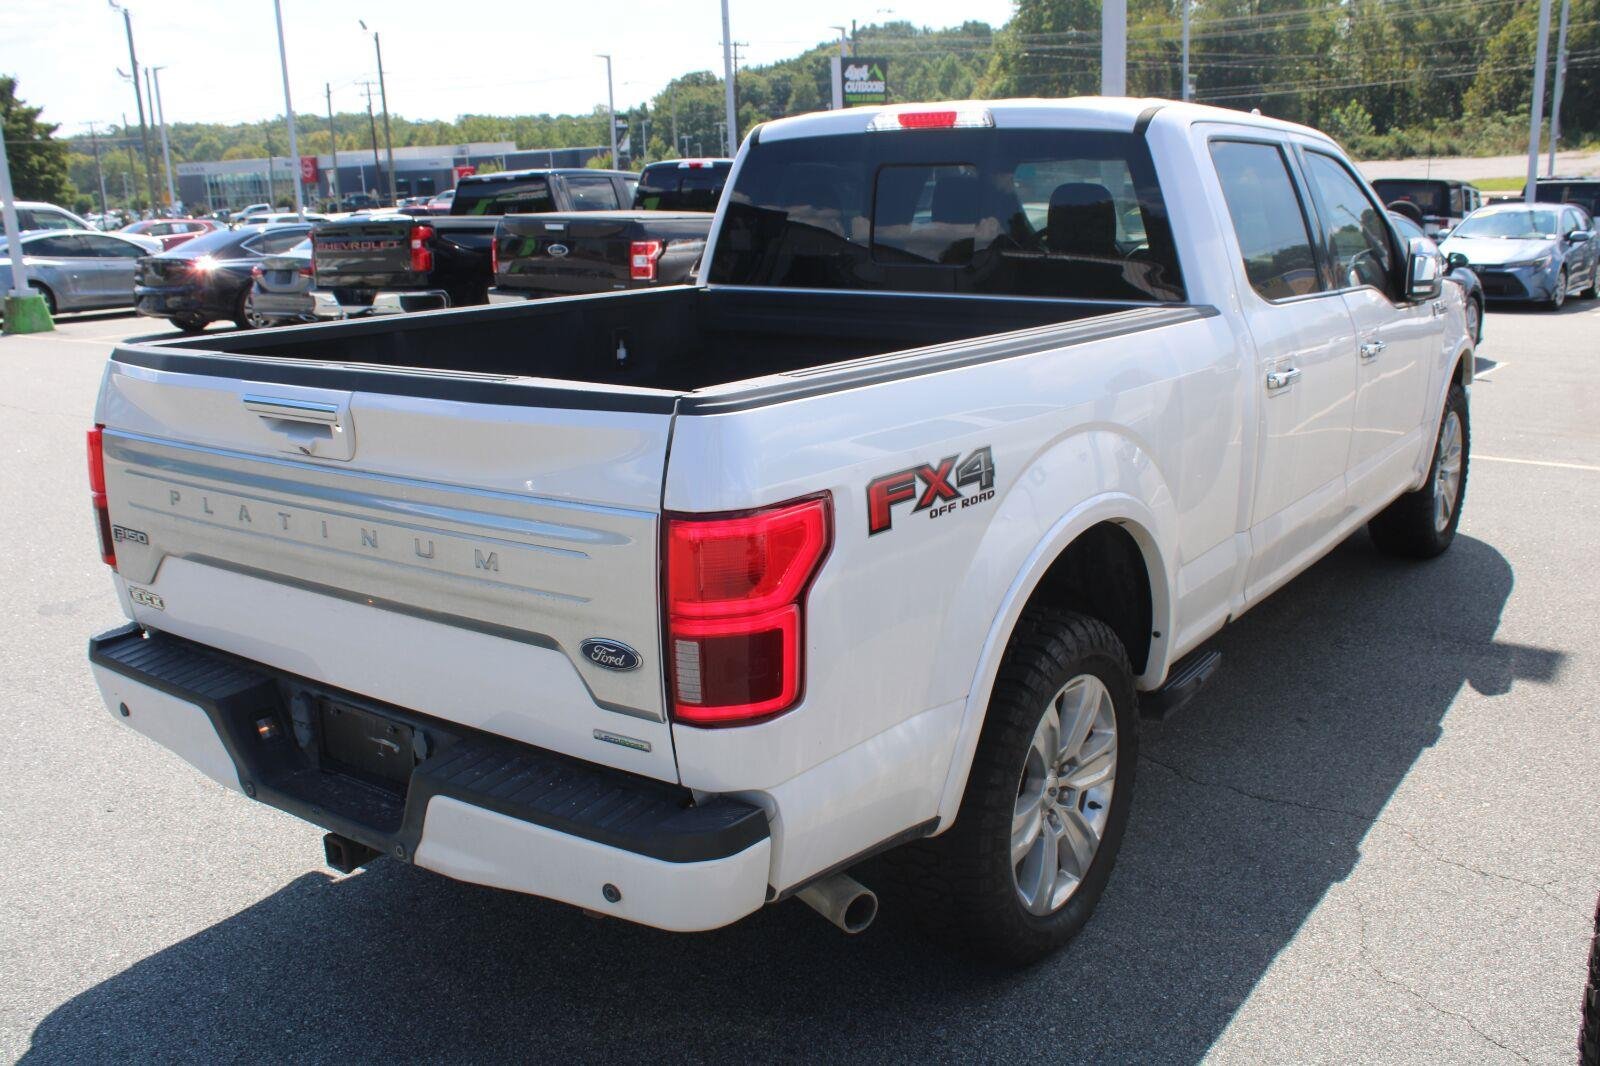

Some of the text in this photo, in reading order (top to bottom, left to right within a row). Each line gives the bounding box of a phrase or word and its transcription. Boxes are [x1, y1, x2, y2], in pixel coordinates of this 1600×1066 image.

[844, 81, 886, 93] OUTDOORS
[315, 241, 400, 251] CHEVROLET
[866, 445, 995, 537] FX4
[929, 489, 995, 519] OFF ROAD
[169, 490, 499, 572] PLATINUM
